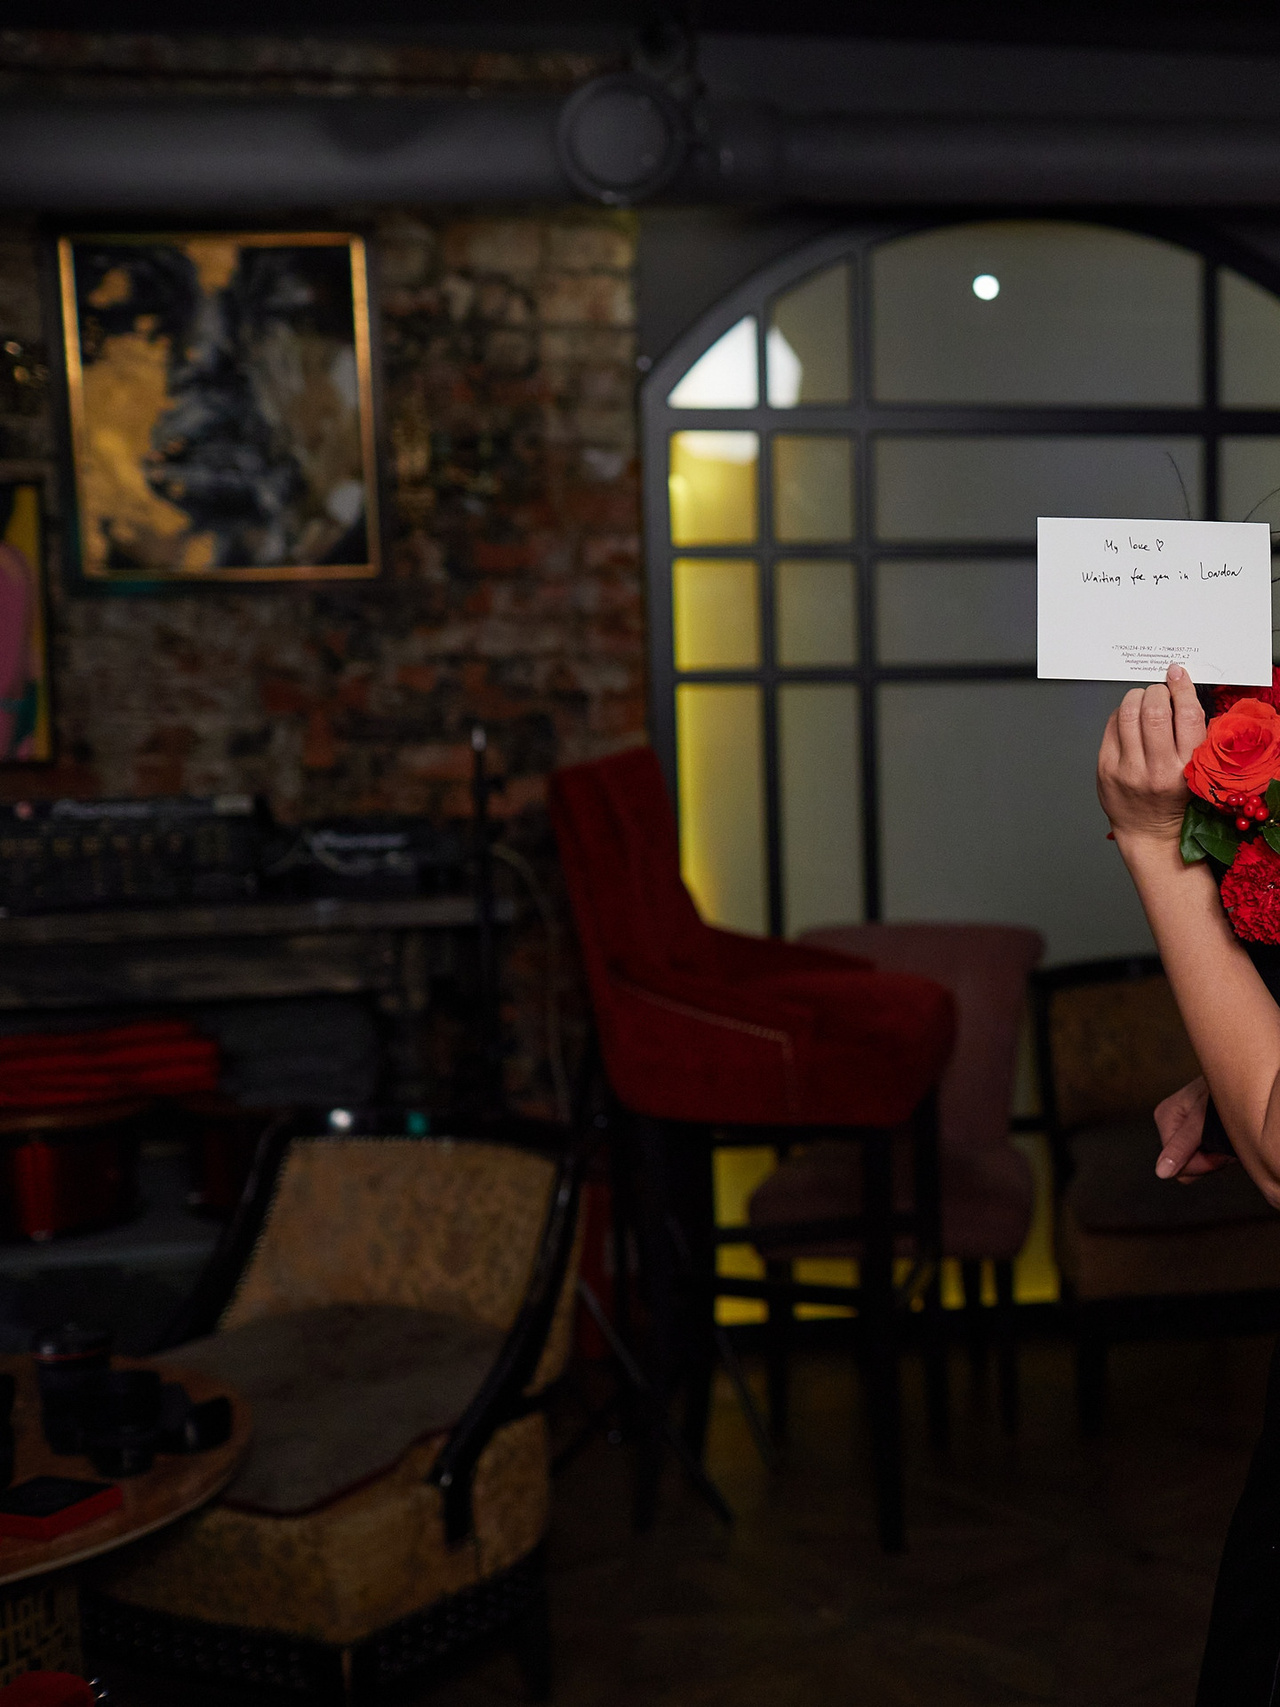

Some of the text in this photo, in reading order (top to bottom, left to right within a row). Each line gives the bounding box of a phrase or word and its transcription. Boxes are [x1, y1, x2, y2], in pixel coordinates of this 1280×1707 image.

[1104, 537, 1150, 554] My love
[1082, 571, 1121, 586] Waiting
[1153, 573, 1170, 585] you
[1179, 571, 1189, 580] in
[1200, 562, 1242, 581] London
